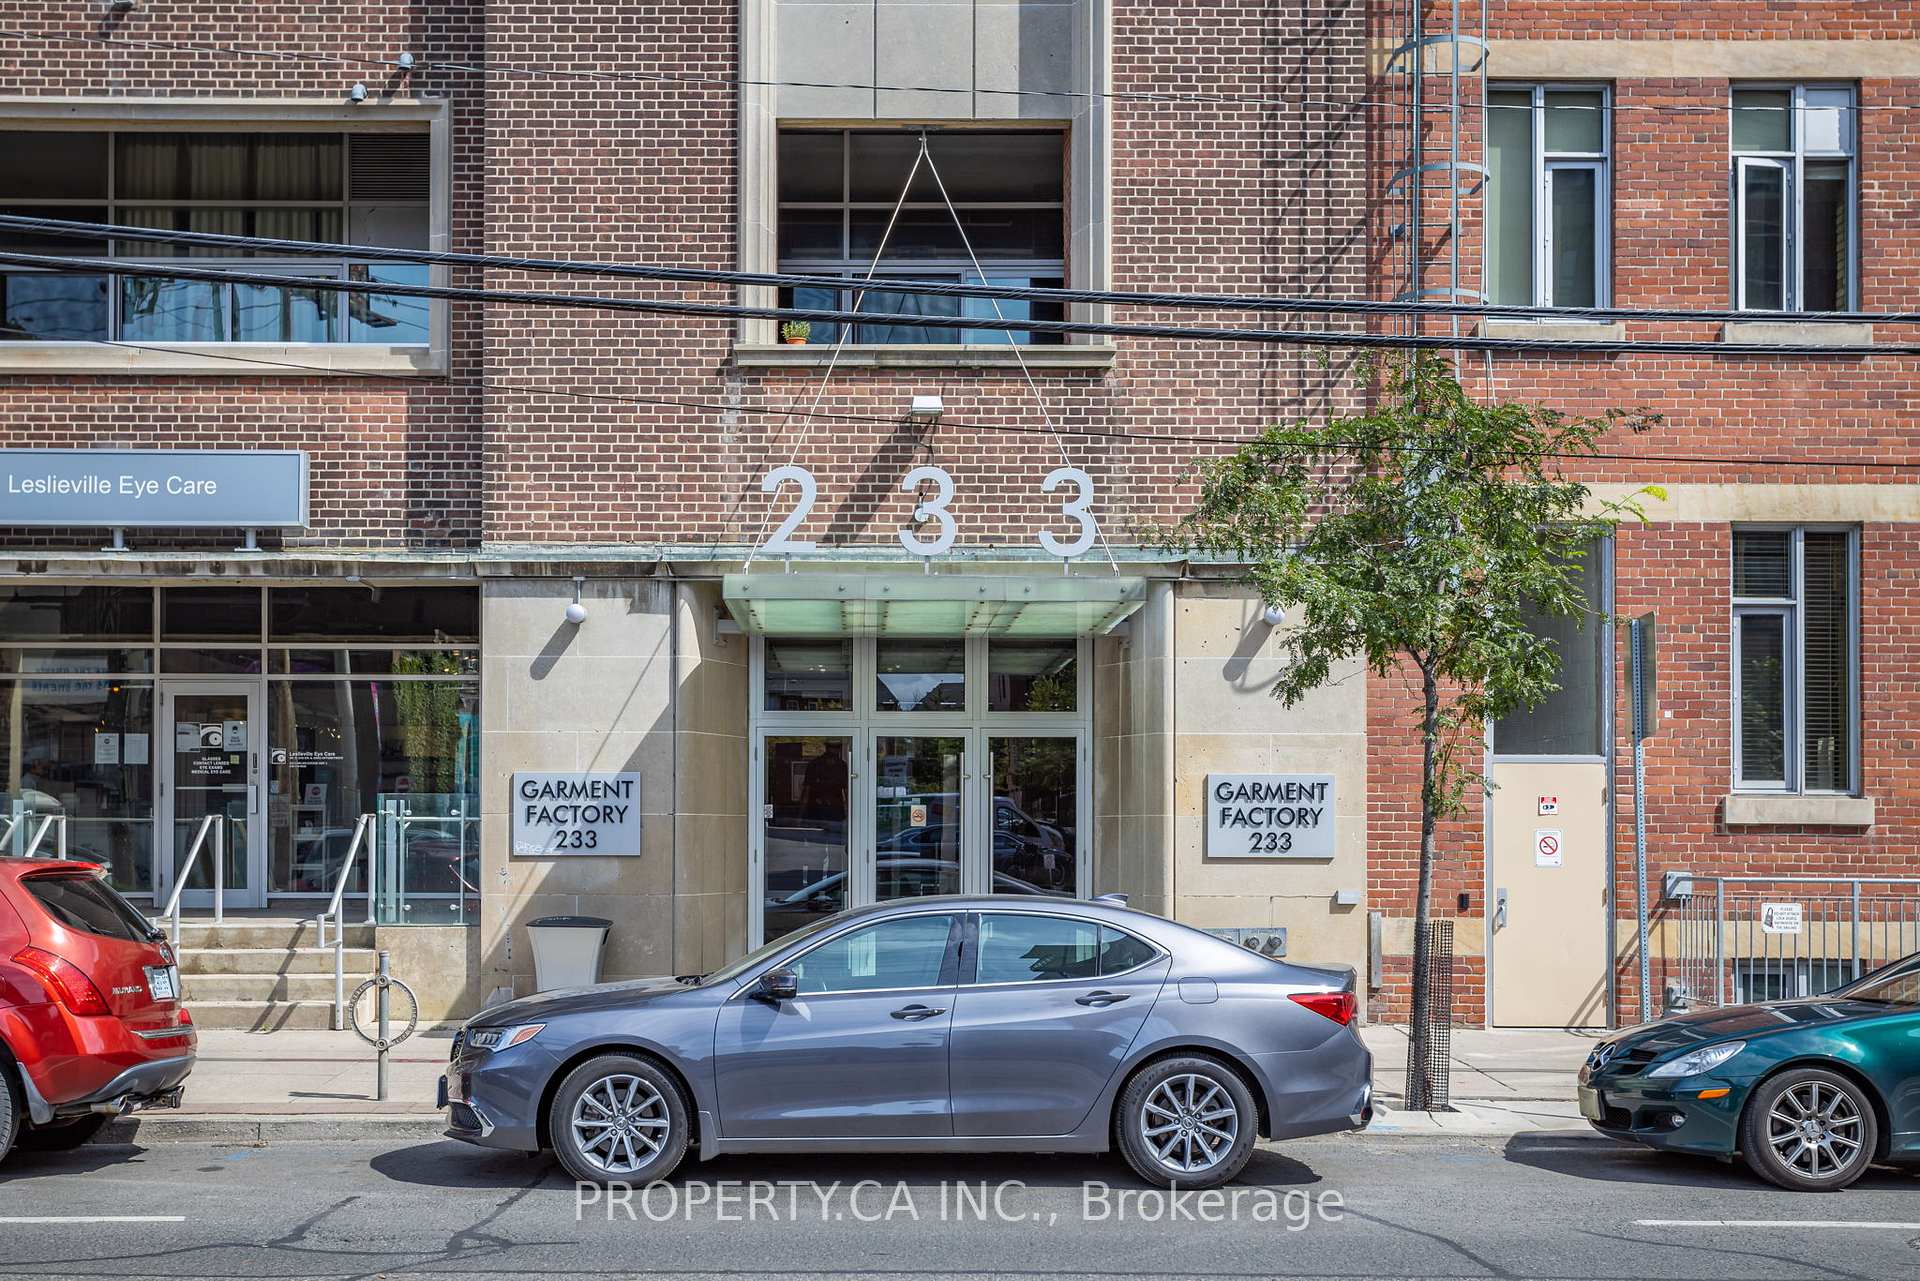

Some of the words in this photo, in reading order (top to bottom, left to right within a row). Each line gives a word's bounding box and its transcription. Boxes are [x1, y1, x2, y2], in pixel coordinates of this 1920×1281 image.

[8, 474, 112, 495] Leslieville
[119, 475, 159, 499] Eye
[166, 475, 217, 495] Care
[521, 780, 634, 799] GARMENT
[1216, 782, 1329, 801] GARMENT
[526, 805, 629, 824] FACTORY
[1221, 807, 1324, 826] FACTORY
[556, 830, 597, 849] 233
[1249, 832, 1292, 851] 233
